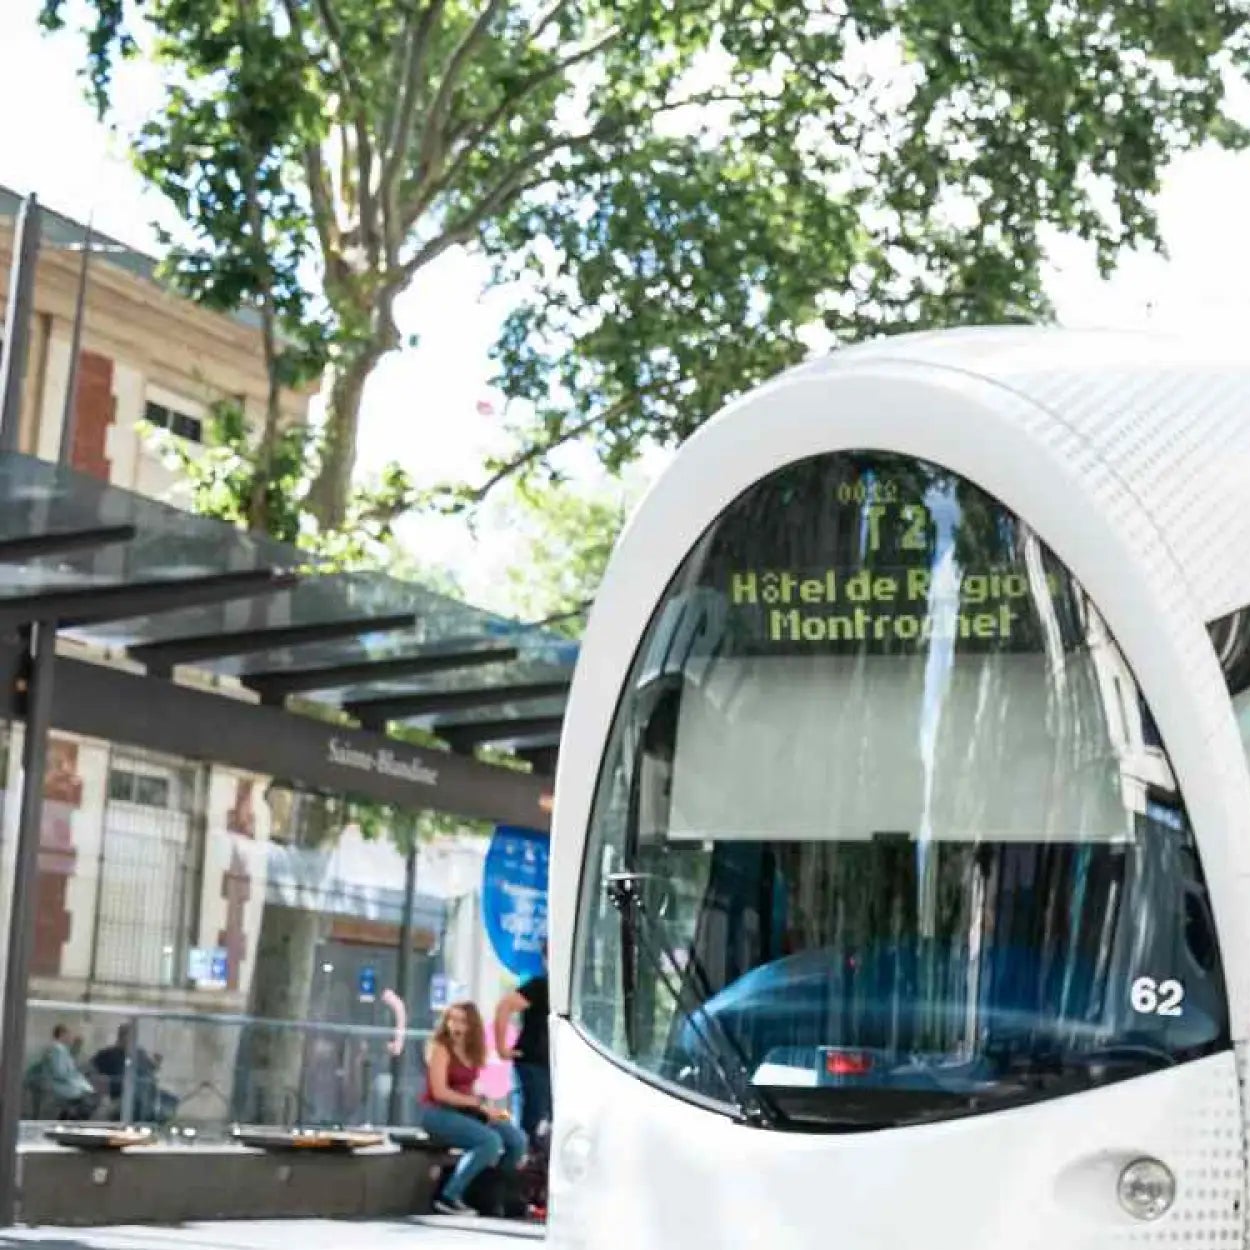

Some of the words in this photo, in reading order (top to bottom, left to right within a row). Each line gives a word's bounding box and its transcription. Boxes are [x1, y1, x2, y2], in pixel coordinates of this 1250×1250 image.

[731, 570, 836, 604] Hôtel
[846, 570, 897, 602] de
[1131, 976, 1184, 1016] 62
